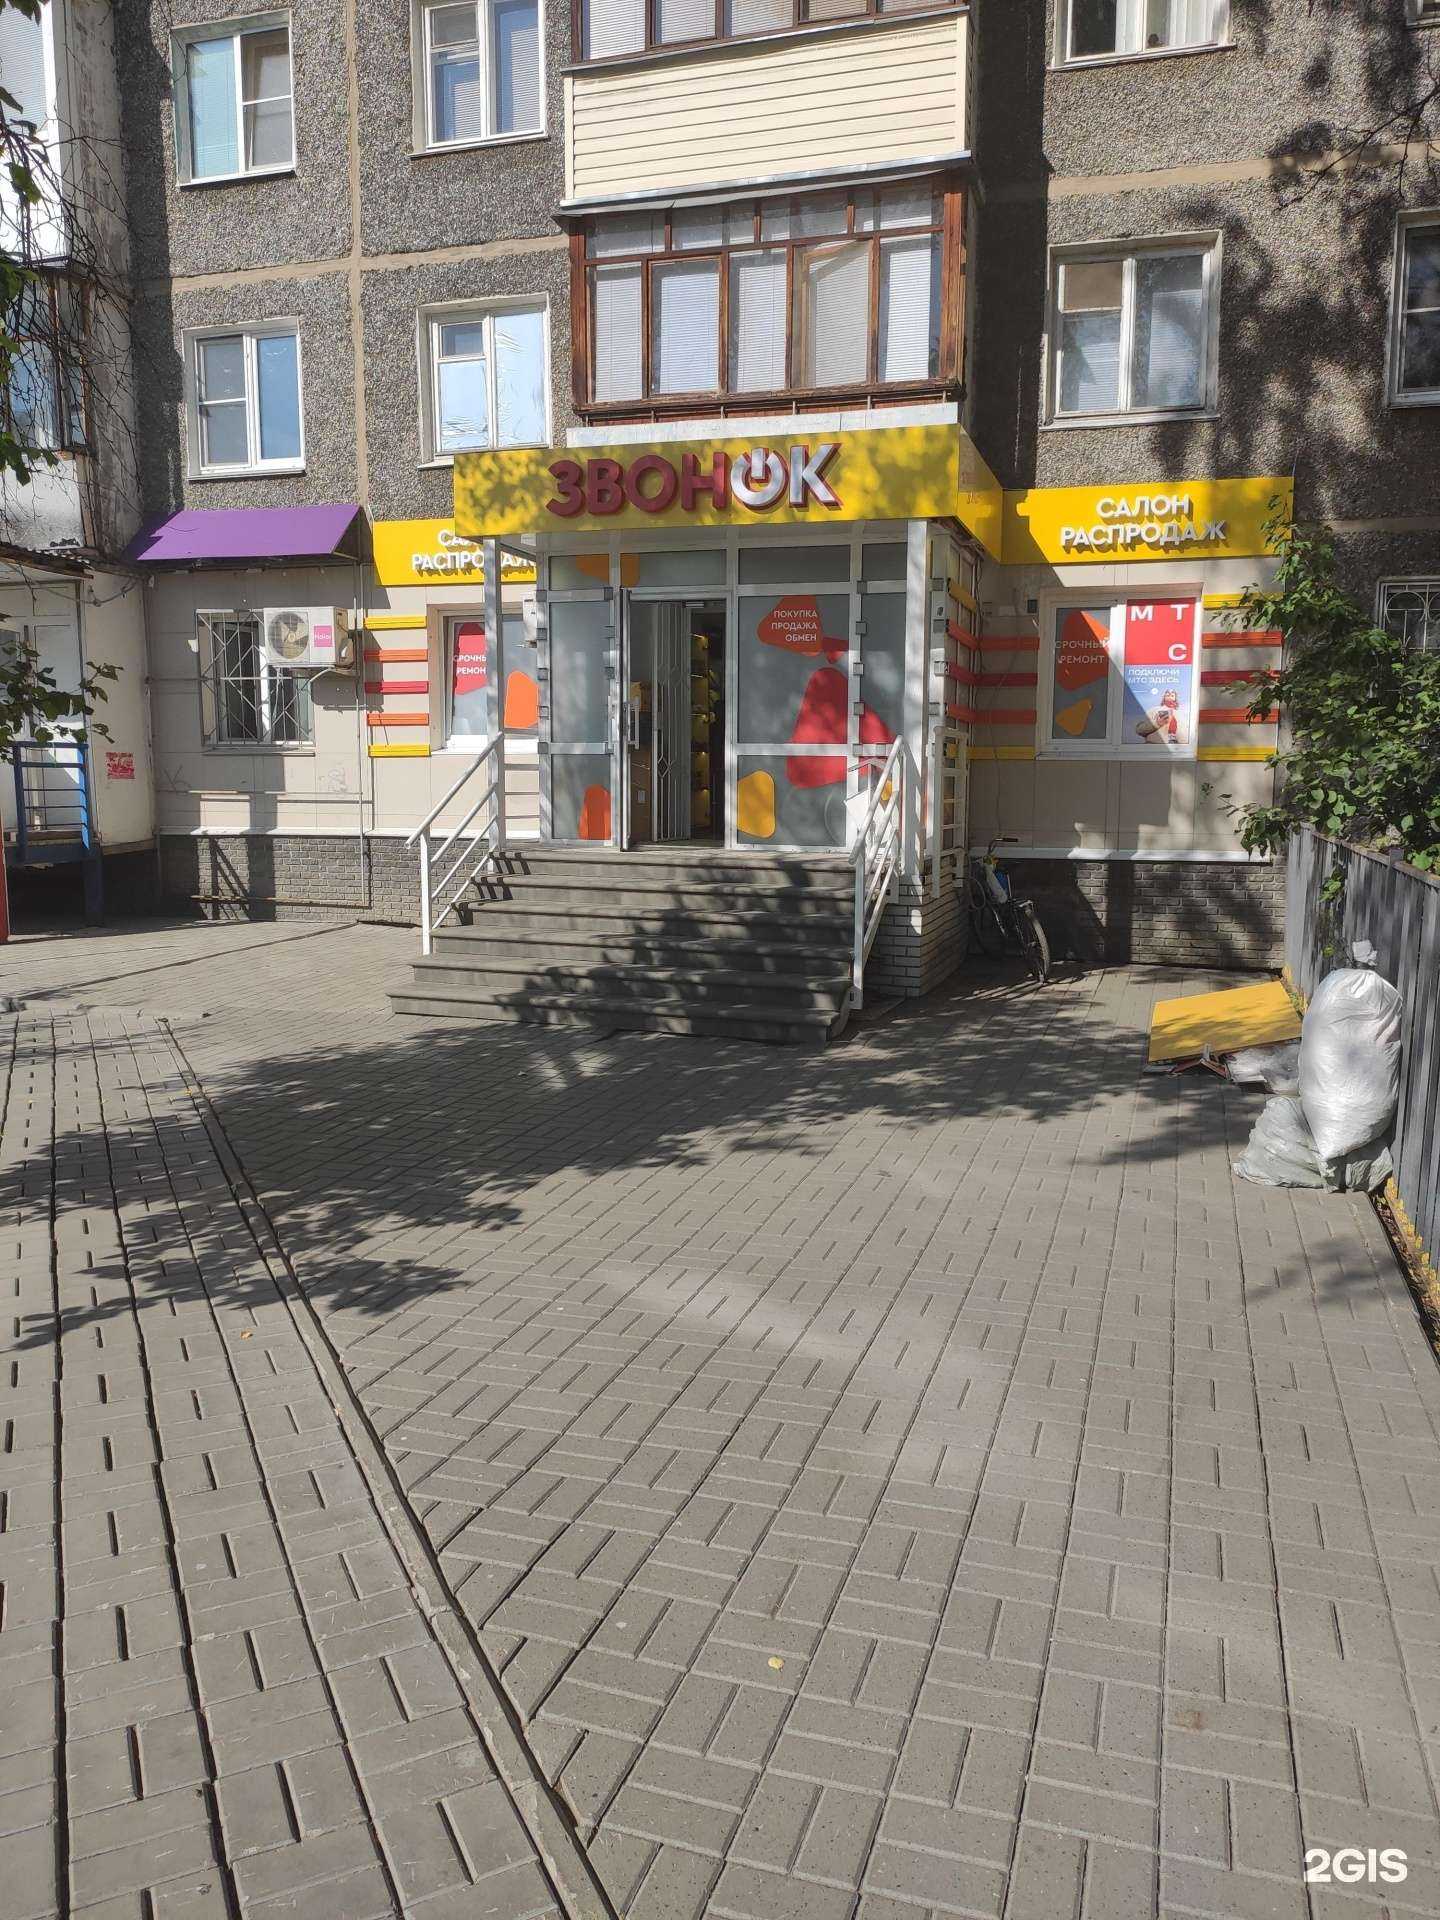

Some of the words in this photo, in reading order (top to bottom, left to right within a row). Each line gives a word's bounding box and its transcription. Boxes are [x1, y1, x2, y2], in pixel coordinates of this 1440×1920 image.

[546, 443, 842, 519] ЗВОНОК
[1095, 494, 1190, 518] САЛОН
[1059, 519, 1227, 546] РАСПРОДАЖ
[773, 610, 818, 618] ПОКУПКА
[771, 622, 818, 631] ПРОДАЖА
[785, 634, 817, 642] ОБМЕН
[1059, 655, 1105, 664] РЕМОНТ
[456, 667, 487, 675] РЕМОН
[1128, 668, 1180, 676] ПОДКЛЮЧИ
